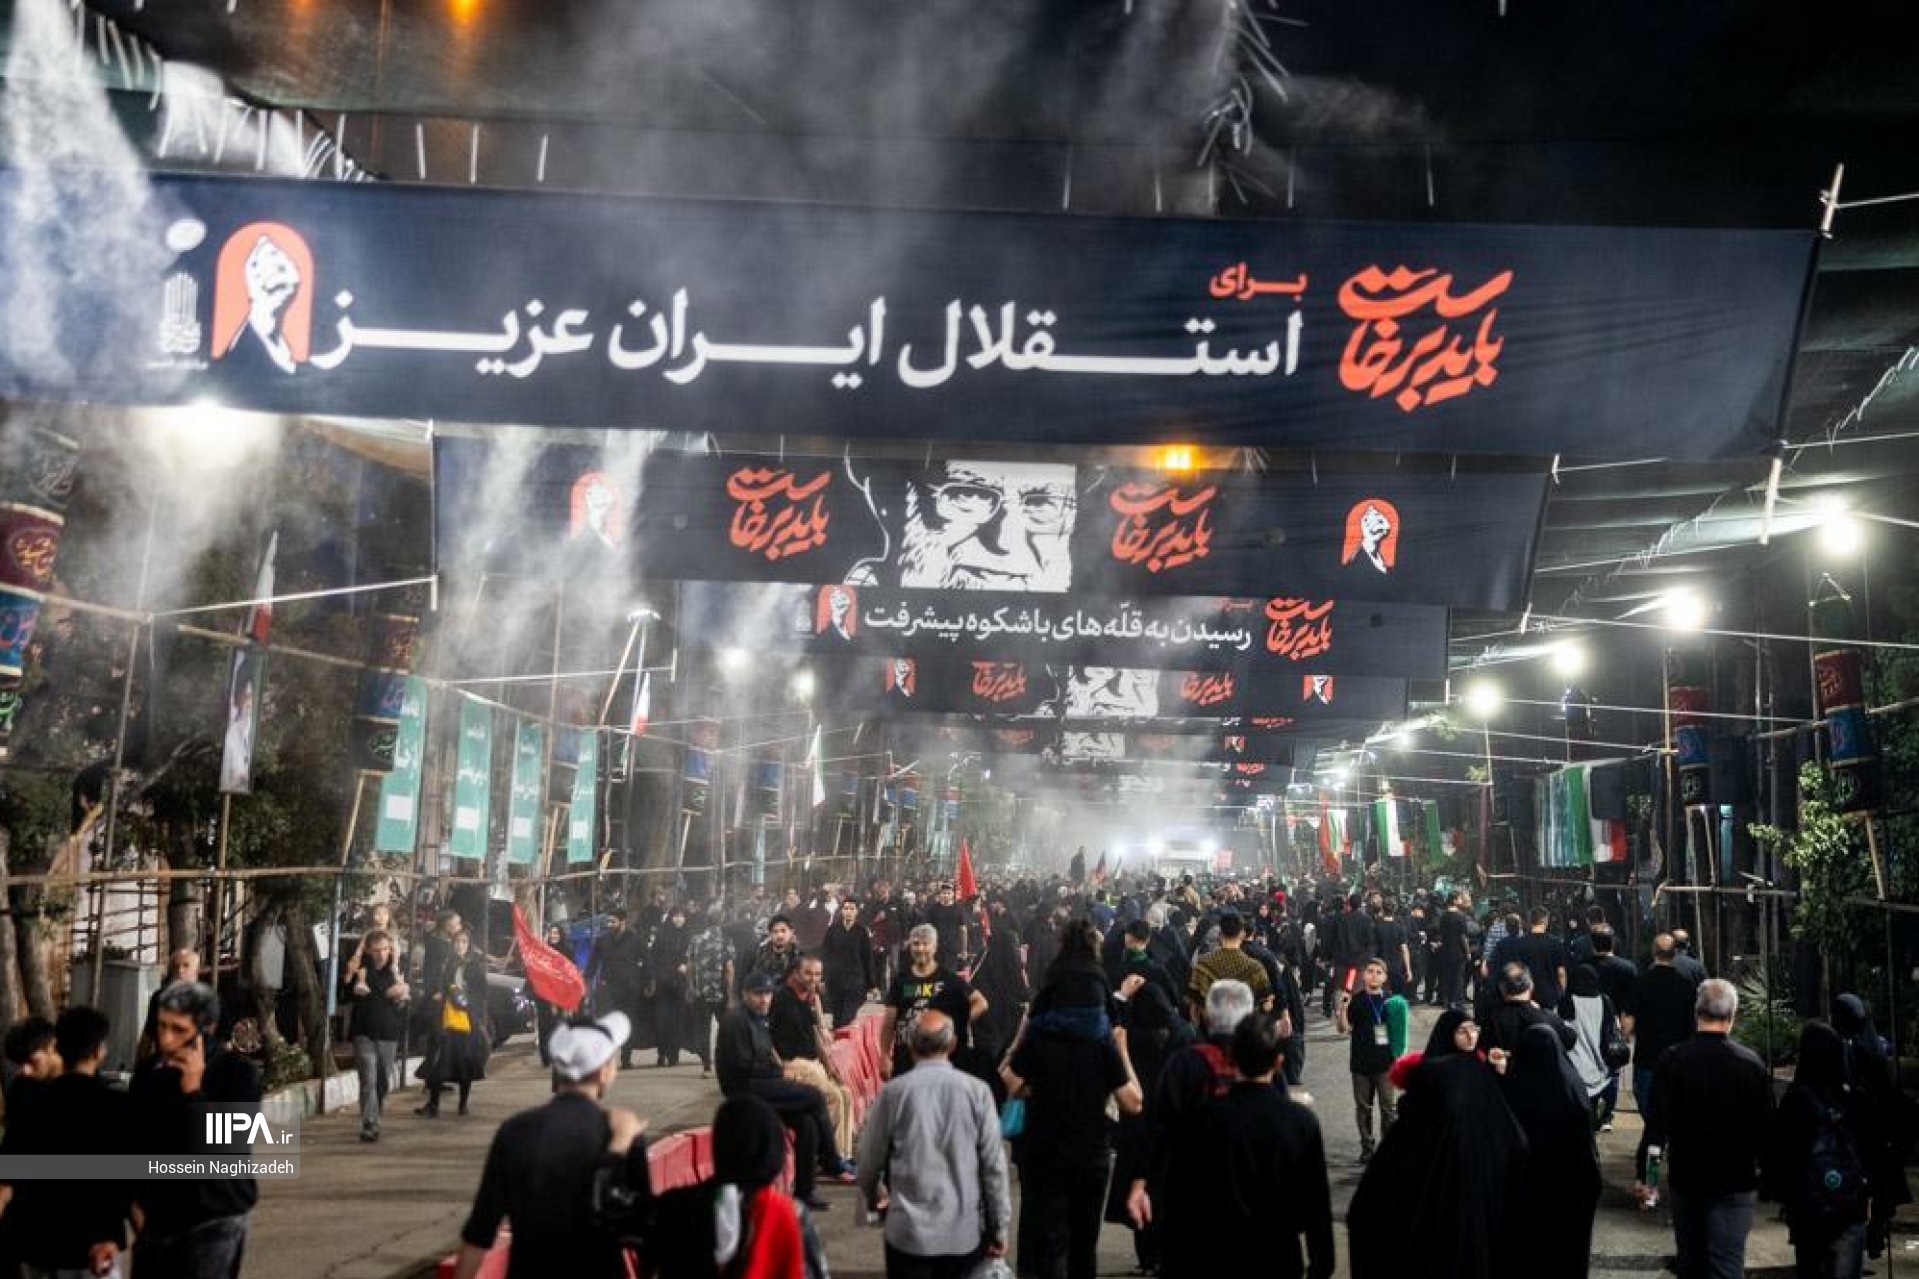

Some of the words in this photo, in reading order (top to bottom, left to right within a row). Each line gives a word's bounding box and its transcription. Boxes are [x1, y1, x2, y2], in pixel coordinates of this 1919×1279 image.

[1210, 263, 1308, 301] برای
[308, 289, 595, 379] عزیز
[607, 287, 887, 390] ایران
[897, 295, 1305, 389] استقلال
[864, 601, 964, 643] پیشرفت
[1143, 618, 1170, 647] به
[1170, 618, 1253, 651] رسیدن
